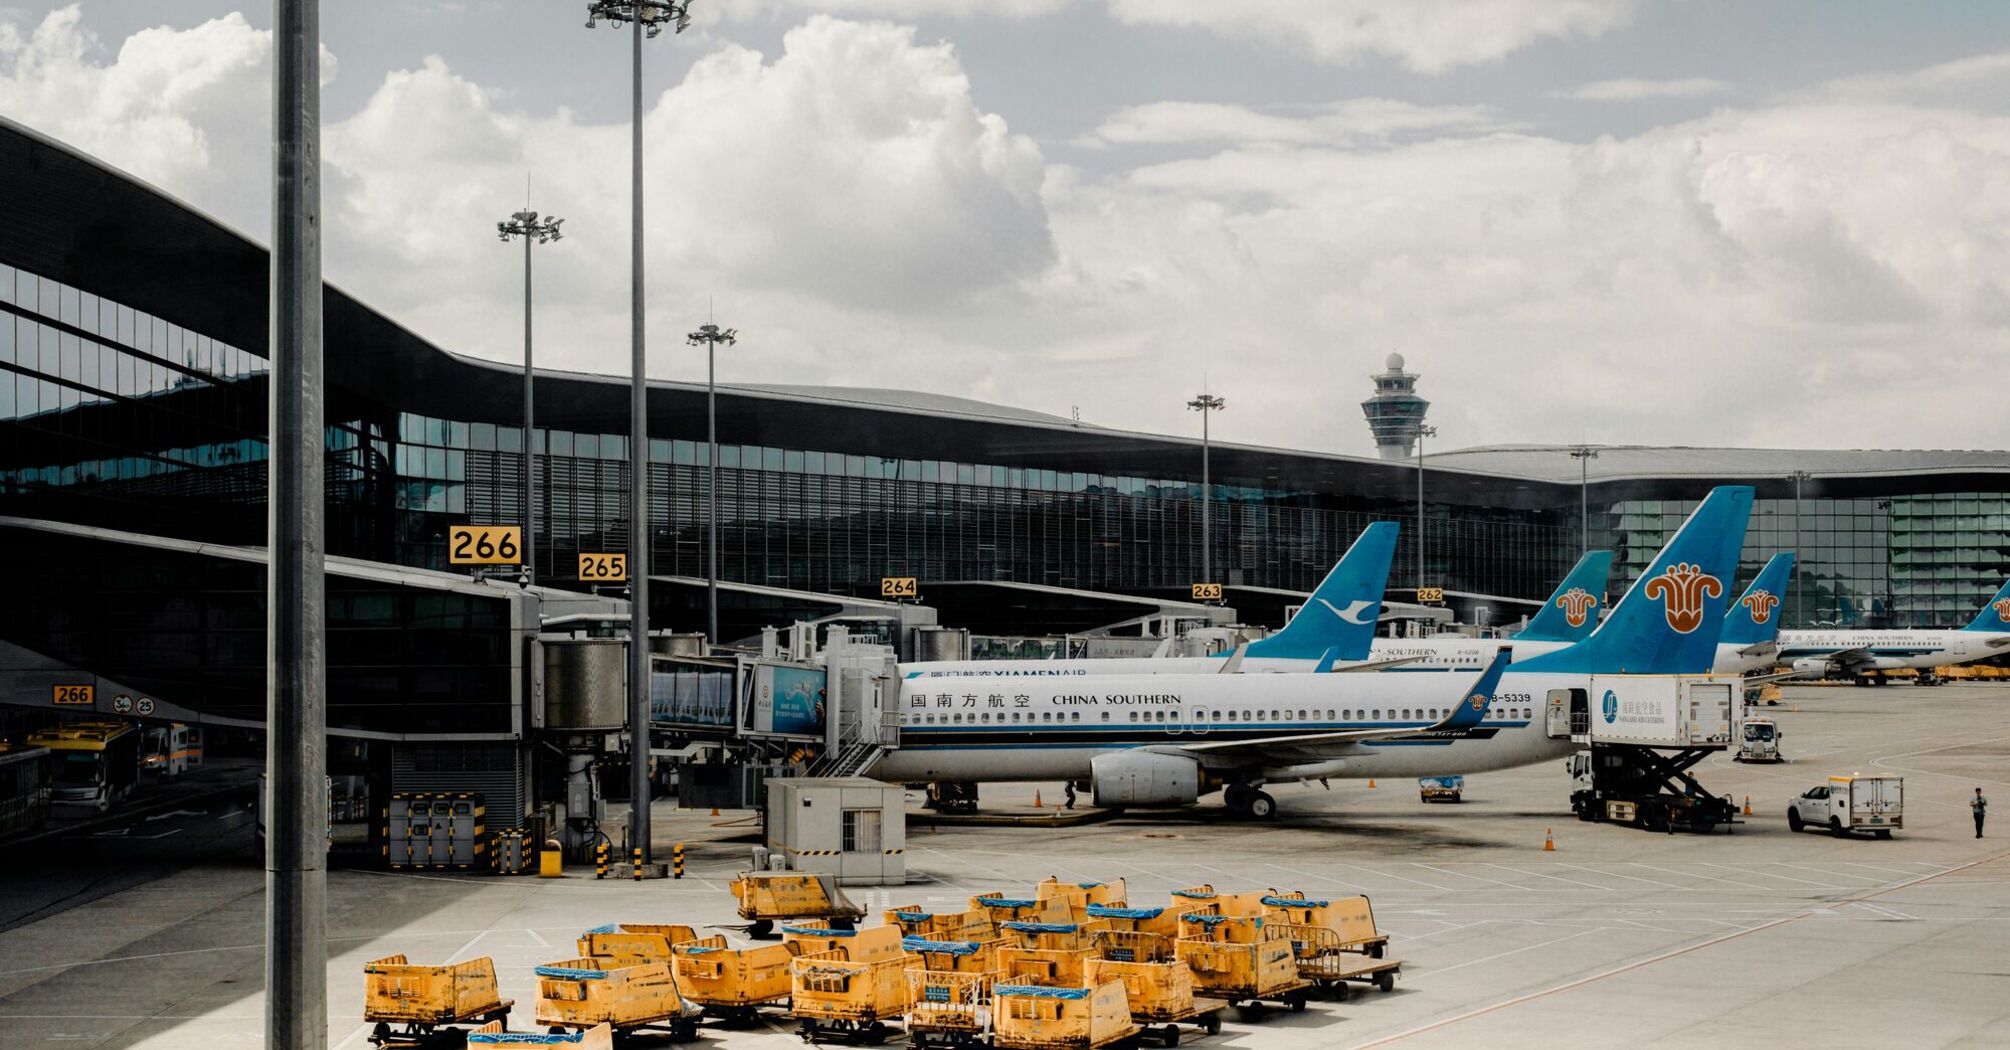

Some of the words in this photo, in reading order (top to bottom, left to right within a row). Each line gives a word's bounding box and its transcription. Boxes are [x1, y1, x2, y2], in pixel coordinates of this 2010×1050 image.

[454, 531, 517, 559] 266
[581, 557, 623, 577] 265
[883, 580, 914, 594] 264
[1194, 585, 1220, 597] 263
[1419, 589, 1441, 600] 262
[1386, 648, 1438, 656] SOUTHERN
[57, 687, 89, 703] 266
[1052, 694, 1098, 705] CHINA
[1105, 694, 1182, 705] SOUTHERN
[1491, 693, 1532, 703] B-5339
[139, 701, 152, 712] 25
